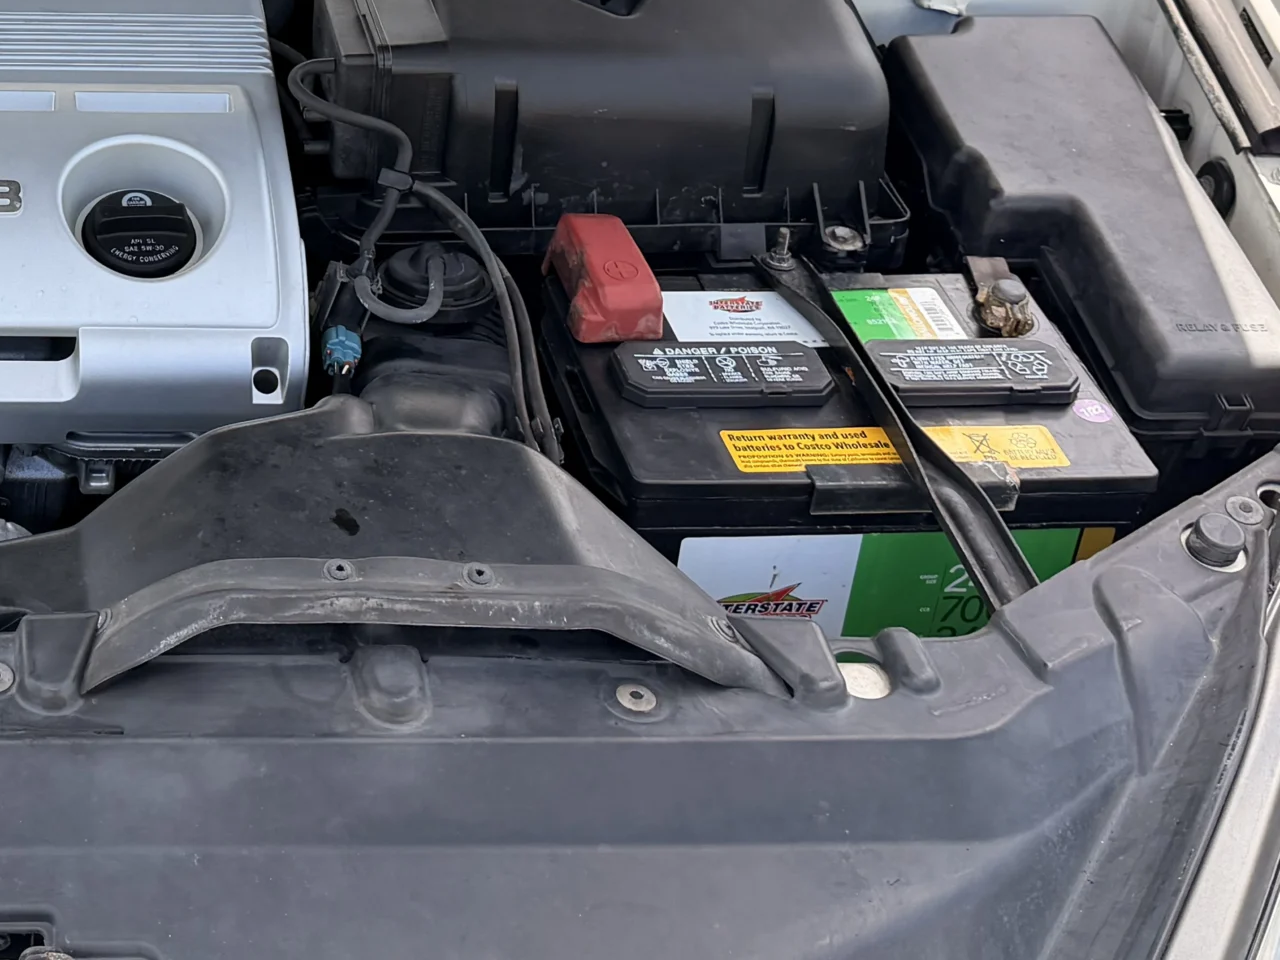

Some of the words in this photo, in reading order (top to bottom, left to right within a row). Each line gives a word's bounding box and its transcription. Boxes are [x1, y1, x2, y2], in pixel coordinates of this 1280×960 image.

[110, 247, 137, 261] ENERGY
[124, 245, 138, 253] SAE
[664, 347, 718, 355] DANGER
[731, 346, 778, 354] POISON
[728, 433, 765, 442] Return
[766, 432, 816, 442] warranty
[817, 431, 840, 440] and
[841, 430, 868, 439] used
[733, 442, 782, 452] batteries
[784, 443, 795, 451] to
[797, 442, 832, 451] Costco
[834, 440, 890, 450] Wholesale
[722, 601, 821, 614] TERSTATE
[940, 595, 991, 623] 70
